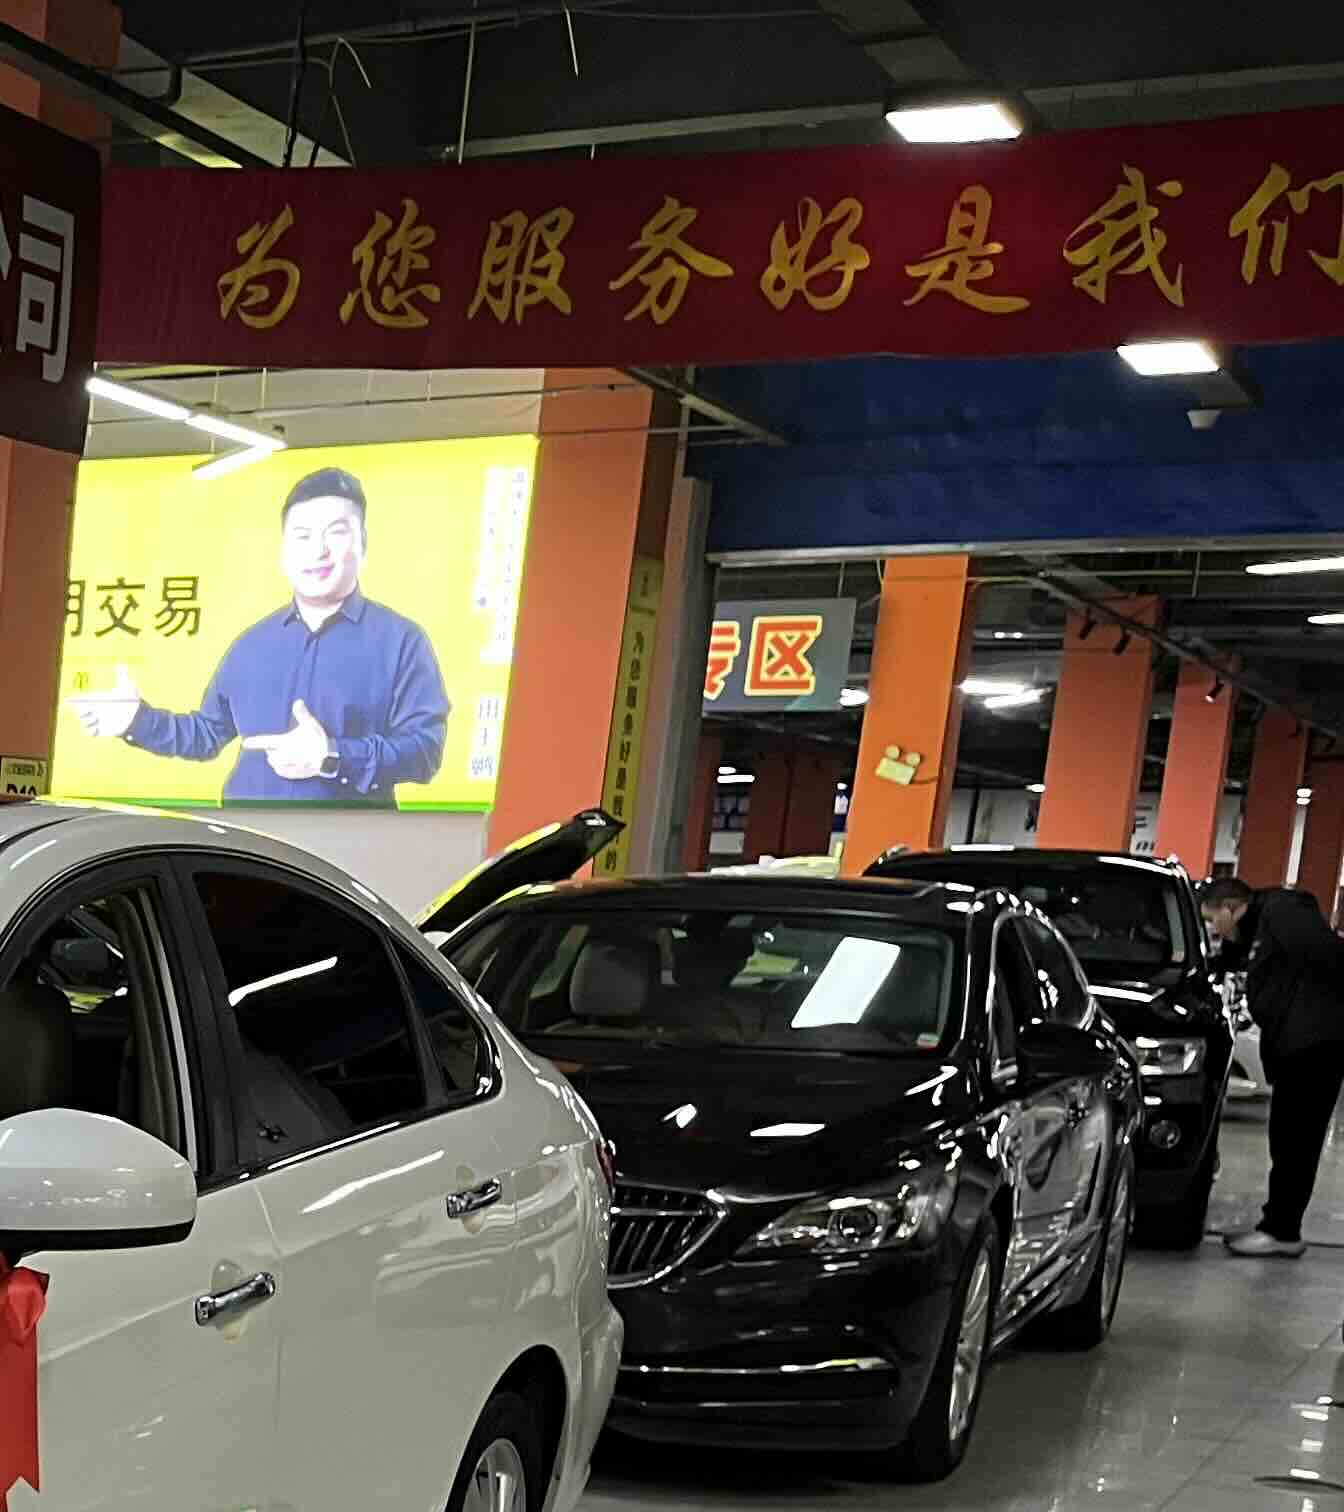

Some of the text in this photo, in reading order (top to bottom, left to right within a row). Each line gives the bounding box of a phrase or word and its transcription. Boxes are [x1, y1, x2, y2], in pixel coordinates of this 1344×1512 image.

[217, 162, 1344, 329] 为您服务好是我们
